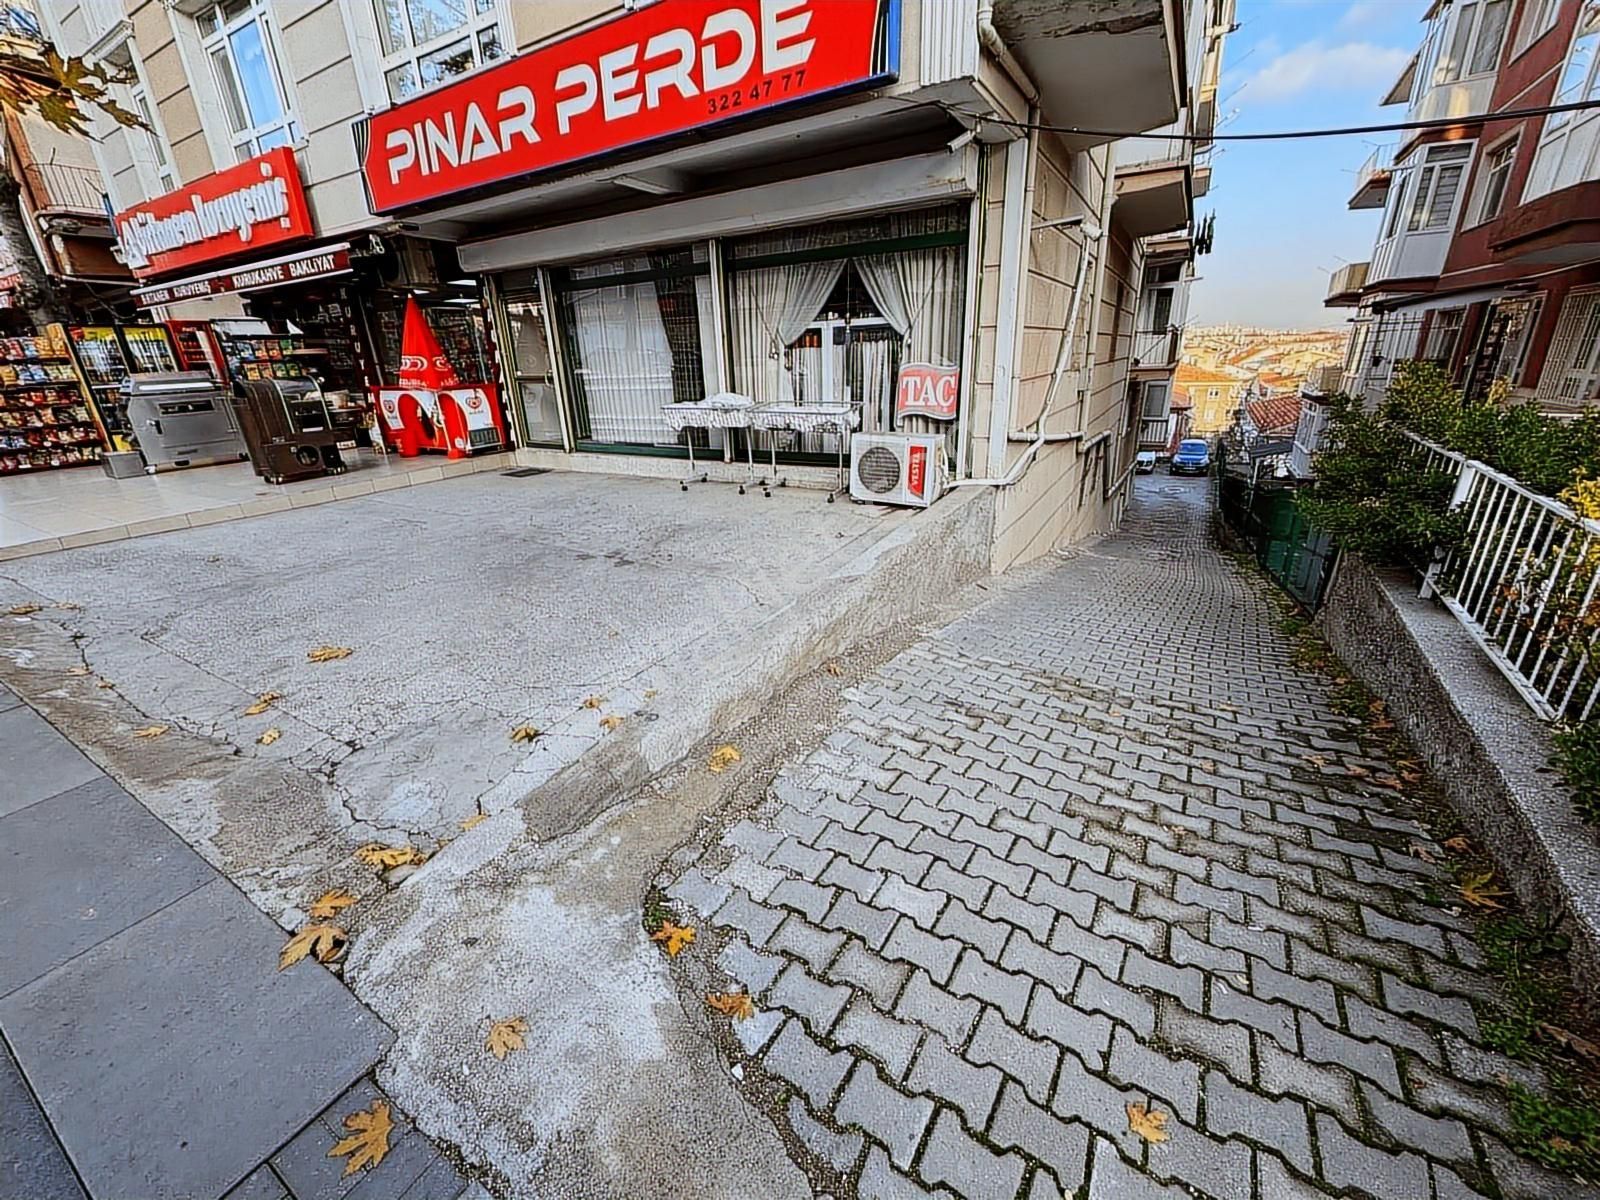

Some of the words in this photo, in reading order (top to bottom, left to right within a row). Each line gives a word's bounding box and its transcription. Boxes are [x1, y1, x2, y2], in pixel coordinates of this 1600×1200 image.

[386, 86, 541, 185] PINAR
[555, 0, 817, 135] PERDE
[707, 90, 742, 115] 322
[749, 80, 773, 101] 47
[781, 69, 806, 92] 77
[231, 265, 285, 289] KURUKAHVE
[289, 254, 335, 278] BAKLİYAT
[903, 375, 956, 412] TAÇ
